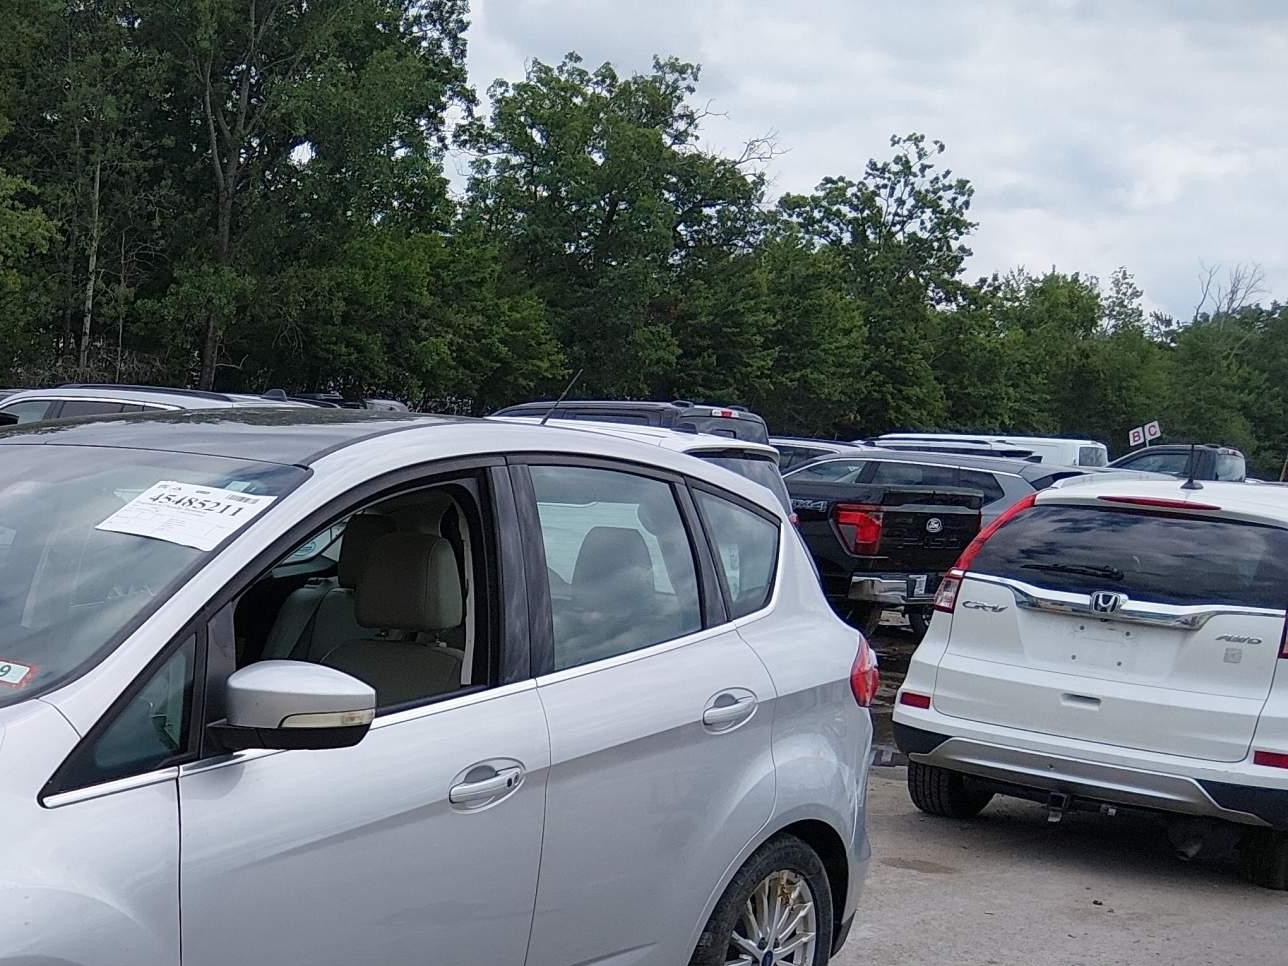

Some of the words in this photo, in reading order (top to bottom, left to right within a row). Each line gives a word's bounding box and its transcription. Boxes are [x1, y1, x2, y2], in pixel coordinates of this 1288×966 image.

[1132, 431, 1141, 443] B
[1148, 424, 1158, 437] C
[149, 493, 244, 517] 45485211
